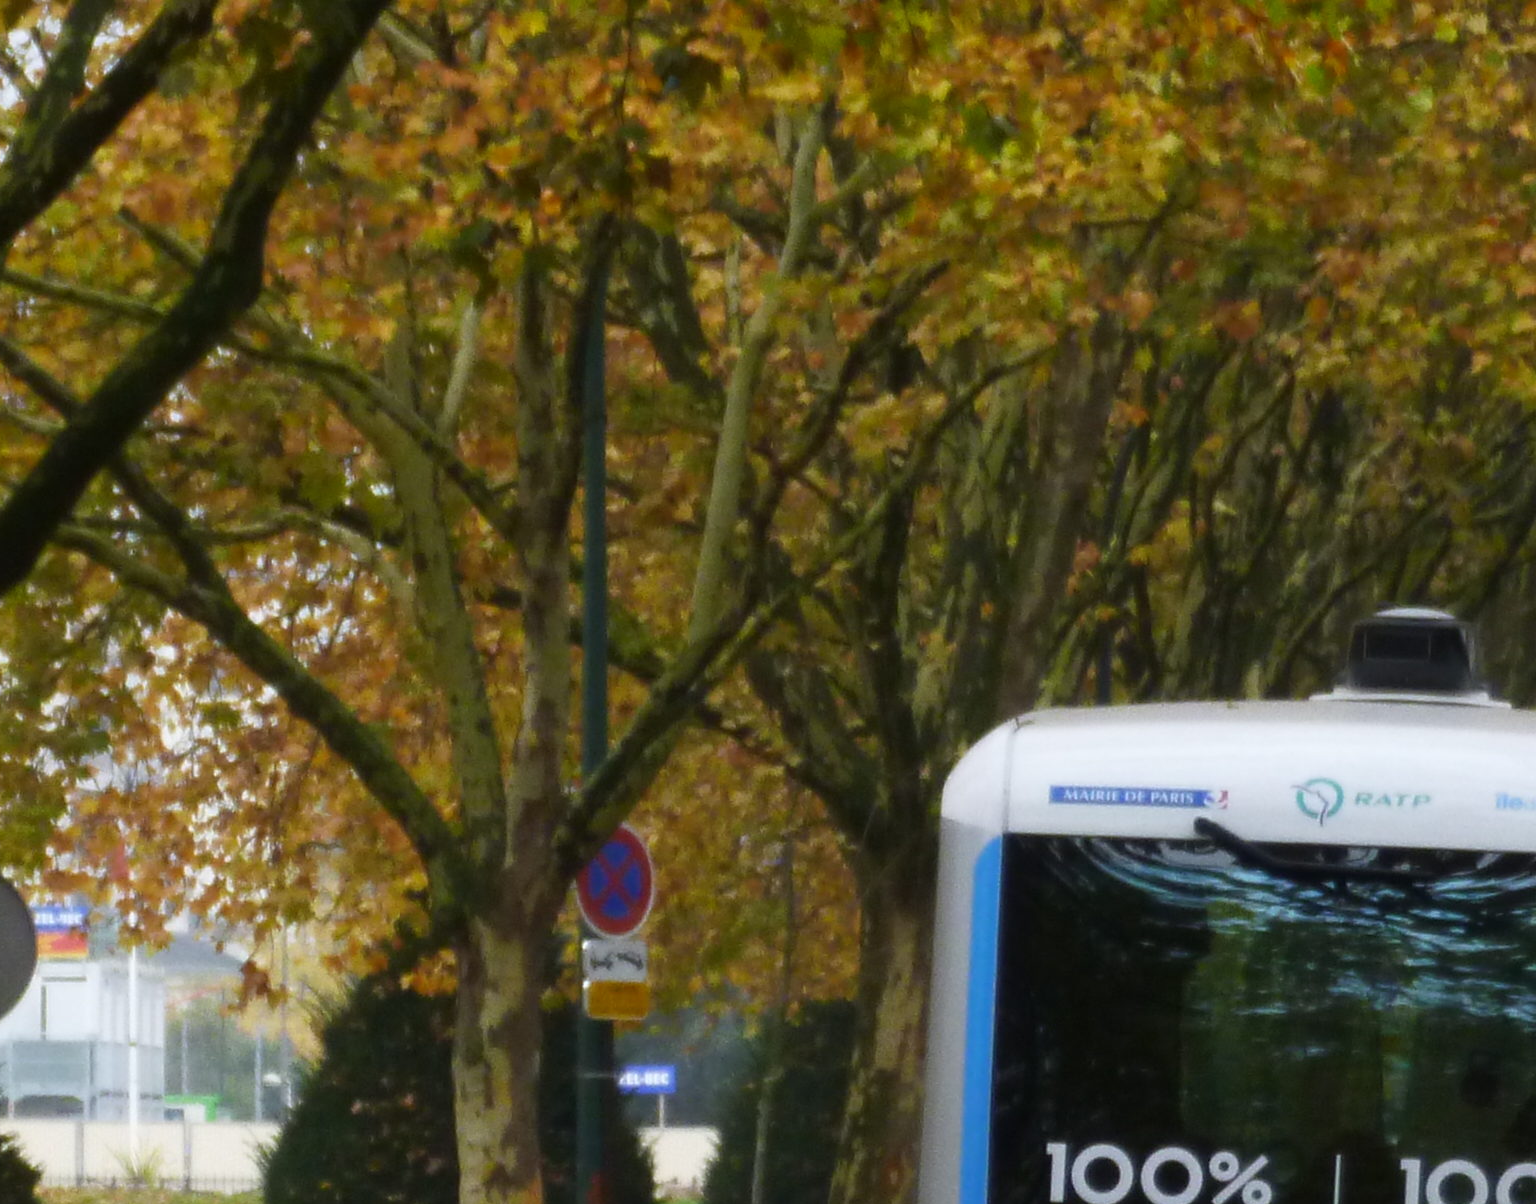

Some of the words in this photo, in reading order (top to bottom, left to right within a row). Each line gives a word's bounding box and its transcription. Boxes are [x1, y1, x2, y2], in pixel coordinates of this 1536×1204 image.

[1063, 789, 1120, 804] MAIRIE
[1126, 790, 1146, 804] DE
[1151, 791, 1194, 805] PARIS
[1354, 792, 1432, 809] RATP
